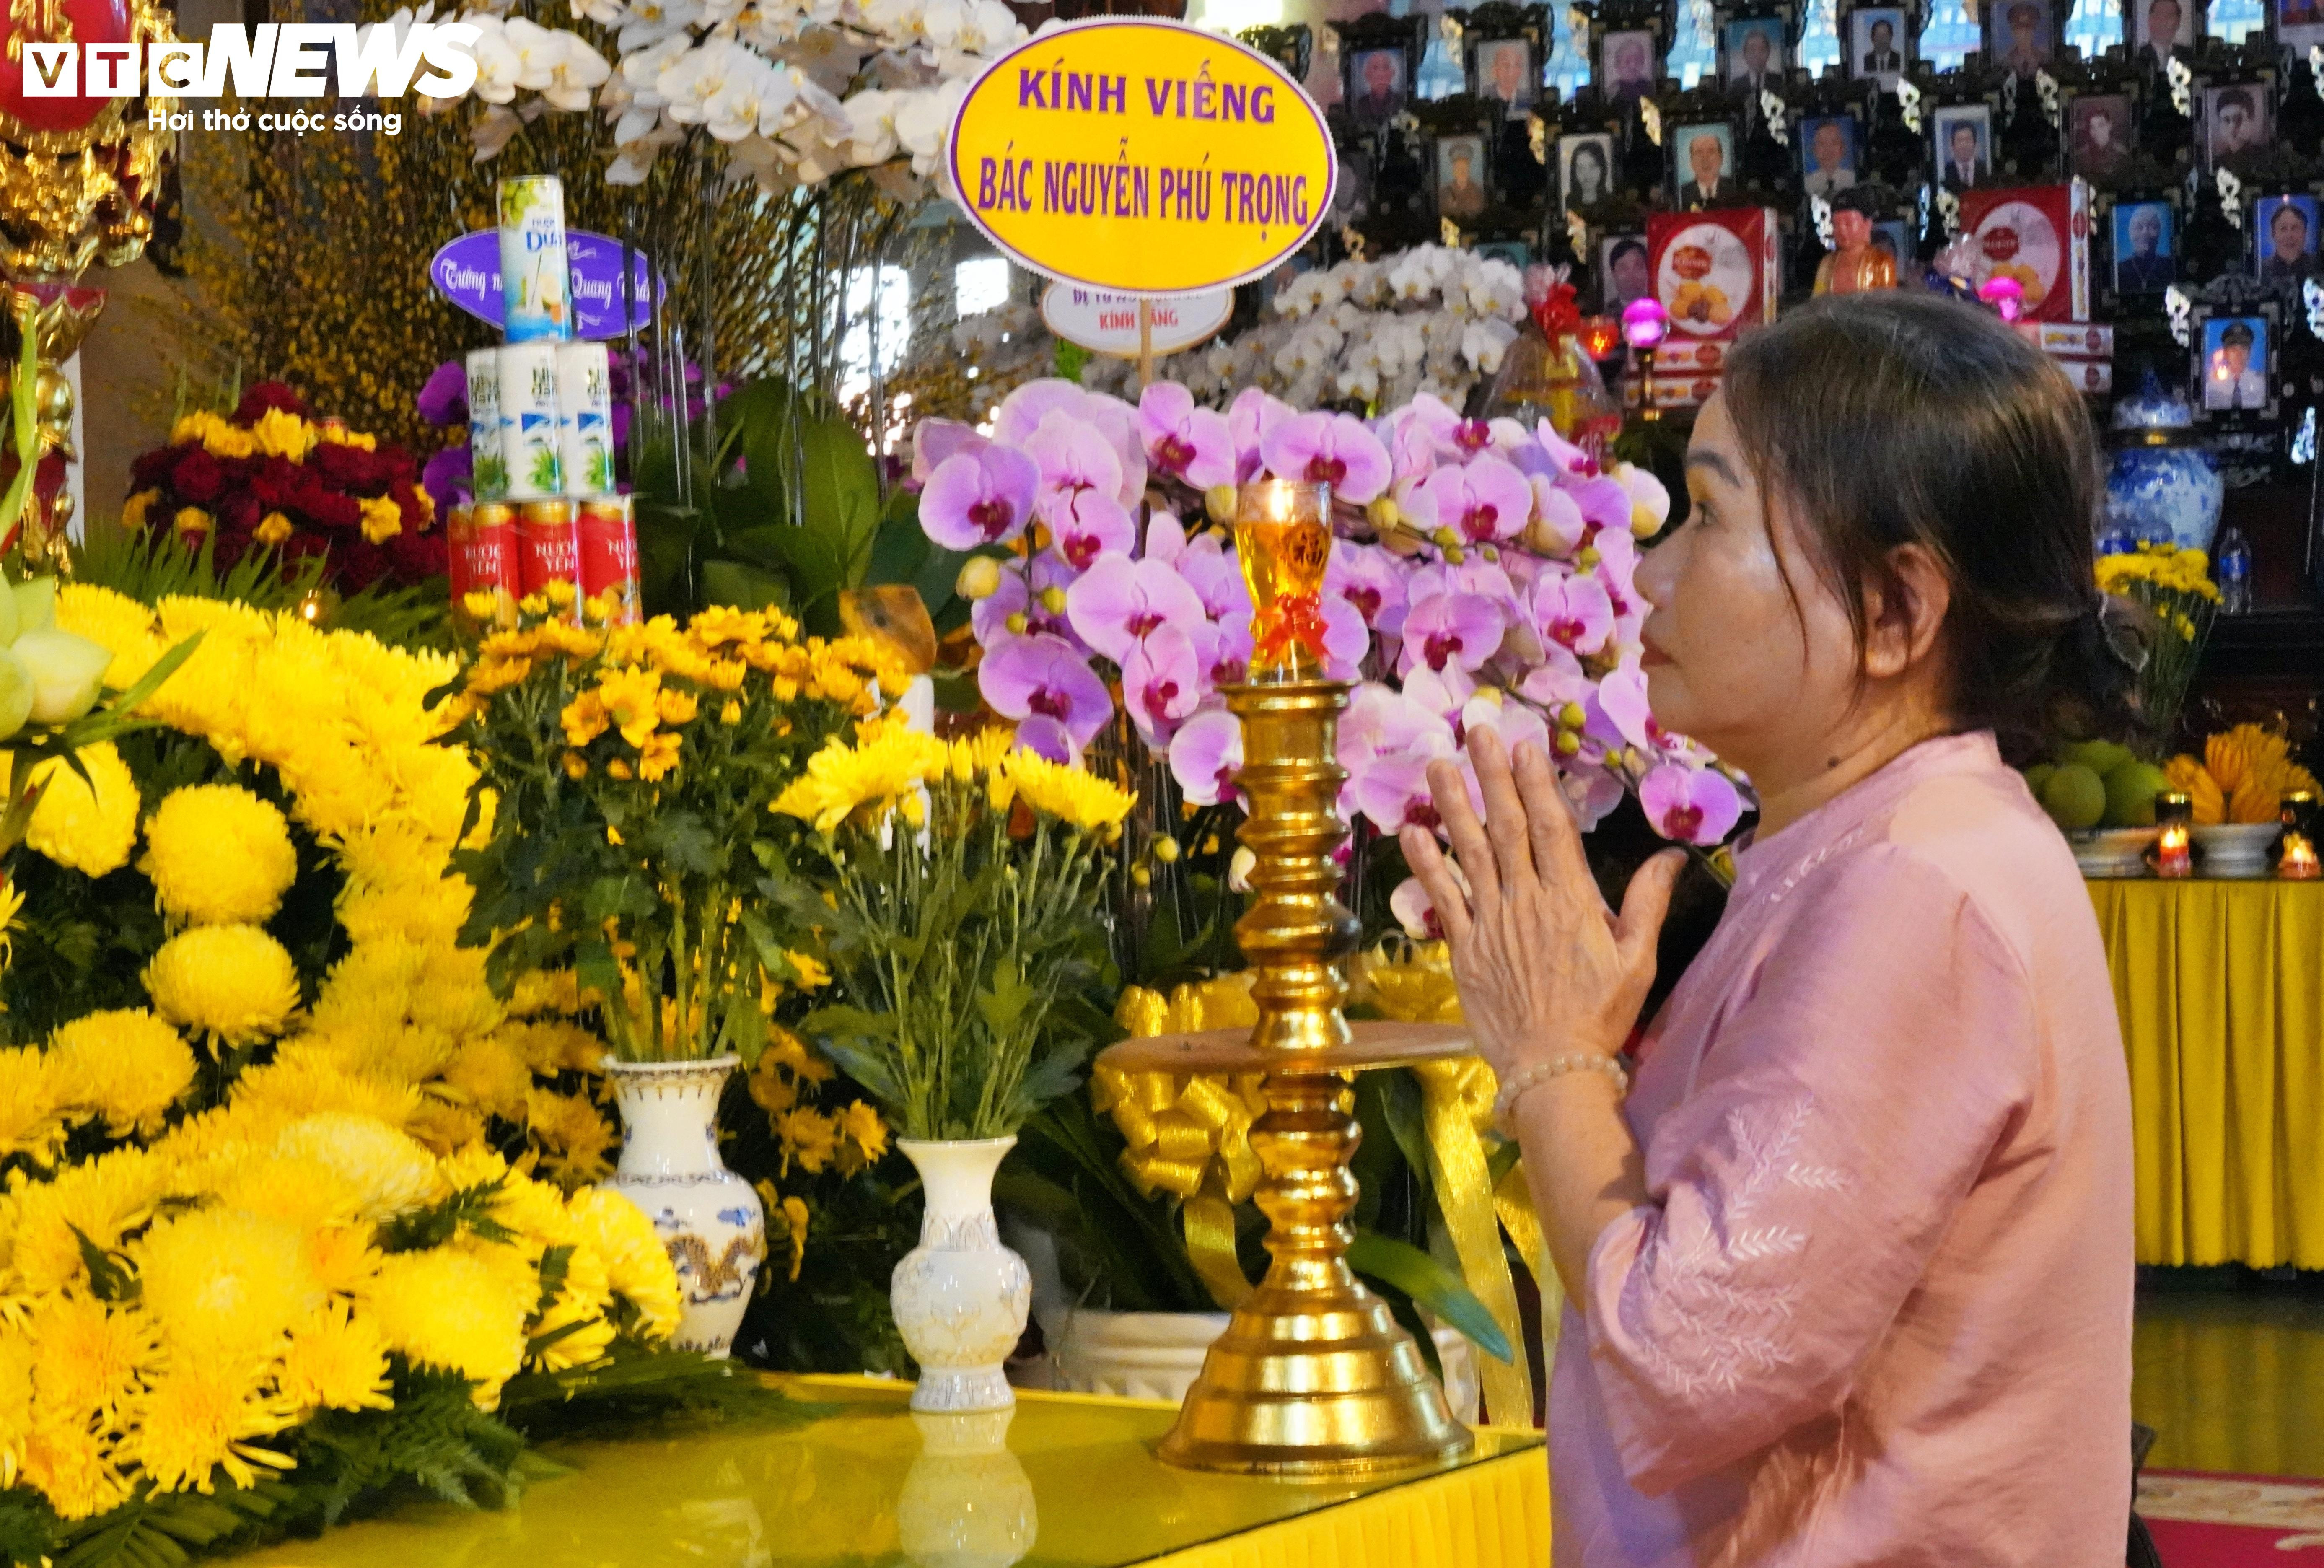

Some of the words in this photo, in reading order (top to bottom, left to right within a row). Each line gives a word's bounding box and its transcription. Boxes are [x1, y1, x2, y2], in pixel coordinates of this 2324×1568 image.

[1018, 57, 1127, 114] KÍNH
[1145, 58, 1275, 124] VIẾNG
[977, 139, 1033, 213] BÁC
[1043, 136, 1150, 218] NGUYỄN
[1159, 151, 1212, 222] PHÚ
[1221, 171, 1308, 242] TRỌNG
[1150, 307, 1179, 327] ÂNG
